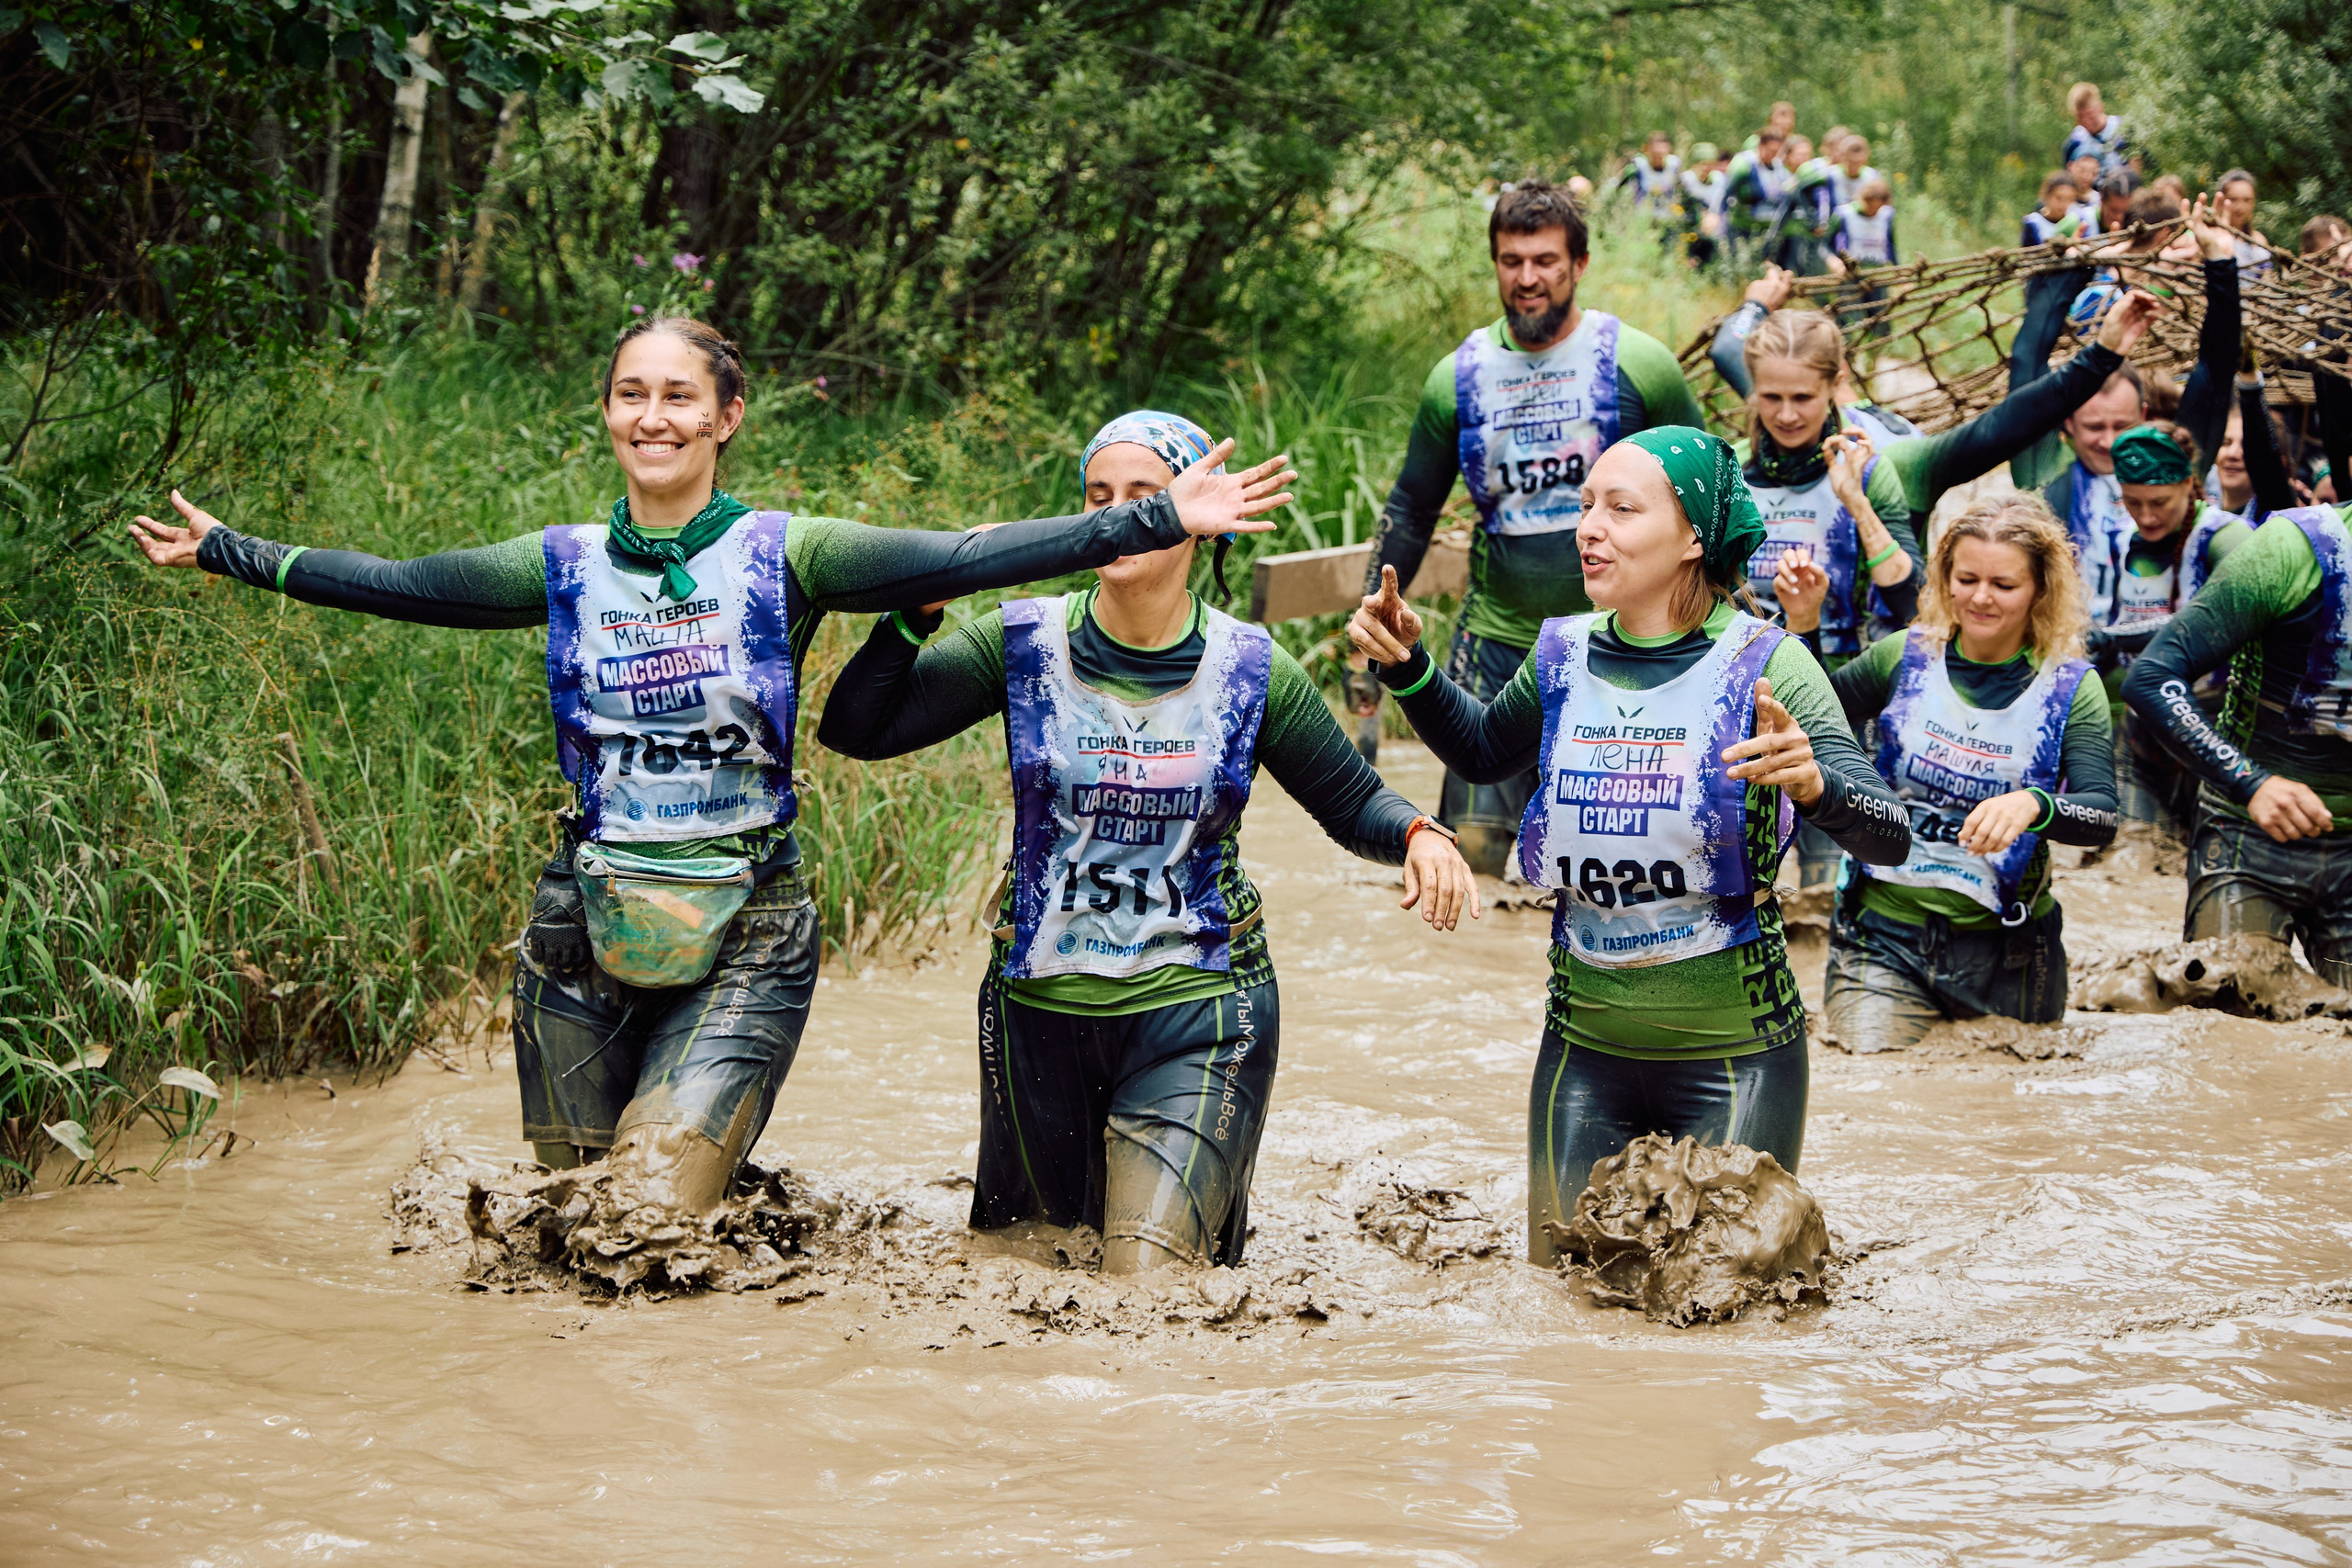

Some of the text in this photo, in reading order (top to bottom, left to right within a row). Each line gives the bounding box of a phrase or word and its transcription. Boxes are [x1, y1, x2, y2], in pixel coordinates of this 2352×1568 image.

[1534, 369, 1576, 379] ГЕРОЕВ
[1495, 400, 1579, 429] МАССОВЫЙ
[1516, 422, 1561, 444] СТАРТ
[1498, 454, 1583, 494] 1588
[601, 598, 719, 626] ГОНКА ГЕРОЕВ
[614, 619, 707, 651] МАША
[601, 644, 726, 687] МАССОВЫЙ
[635, 679, 697, 714] СТАРТ
[1574, 725, 1687, 740] ГОНКА ГЕРОЕВ
[1926, 720, 2013, 754] ГОНКА ГЕРОЕВ
[2159, 680, 2243, 771] Greenway
[616, 723, 753, 777] 1642
[1077, 736, 1196, 754] ГОНКА ГЕРОЕВ
[1560, 773, 1678, 805] МАССОВЫЙ
[1909, 759, 2007, 801] МАССОВЫЙ
[656, 792, 749, 818] ГАЗПРОМБАНК
[1078, 782, 1196, 817] МАССОВЫЙ
[1097, 814, 1161, 843] СТАРТ
[1583, 806, 1645, 833] СТАРТ
[1866, 823, 1904, 841] GLOBAL
[1061, 862, 1182, 919] 1511
[1556, 856, 1688, 910] 1620
[1602, 924, 1695, 951] ГАЗПРОМБАНК
